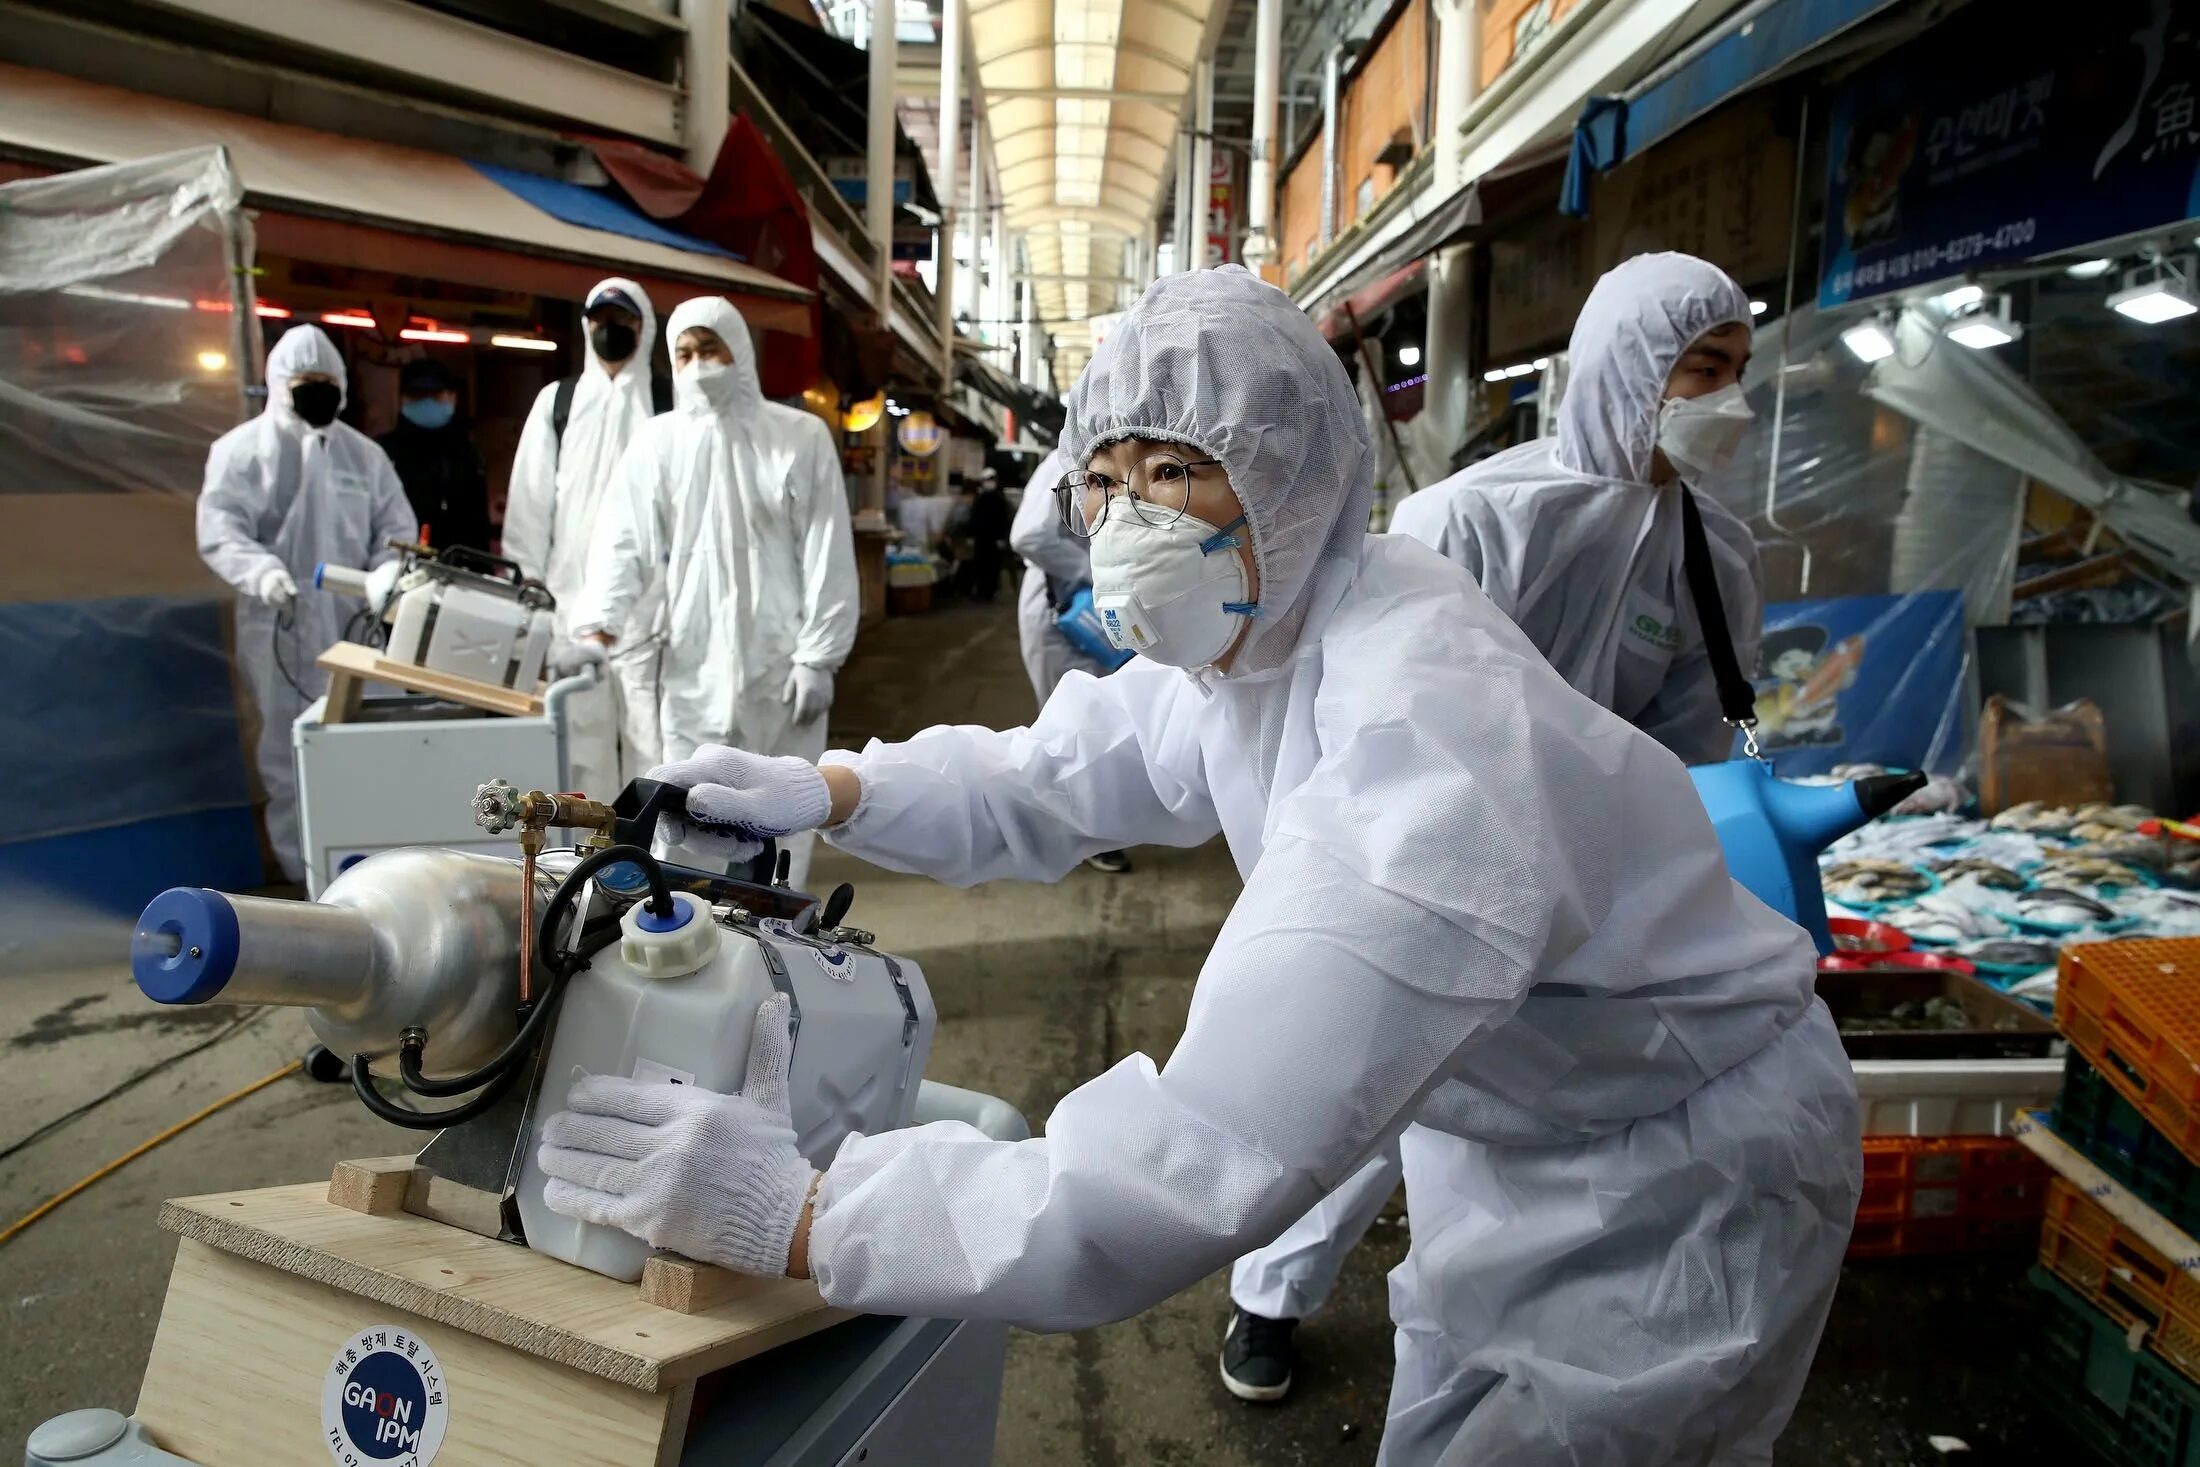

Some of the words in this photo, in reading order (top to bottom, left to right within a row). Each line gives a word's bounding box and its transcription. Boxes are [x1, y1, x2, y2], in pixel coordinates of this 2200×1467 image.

[1104, 609, 1117, 620] 3M
[335, 1348, 357, 1376] 해충
[361, 1332, 387, 1352] 방제
[393, 1334, 419, 1359] 토탈
[421, 1359, 443, 1406] 시스템
[344, 1381, 412, 1424] GAON
[329, 1427, 345, 1453] TEL
[375, 1418, 420, 1453] IPM
